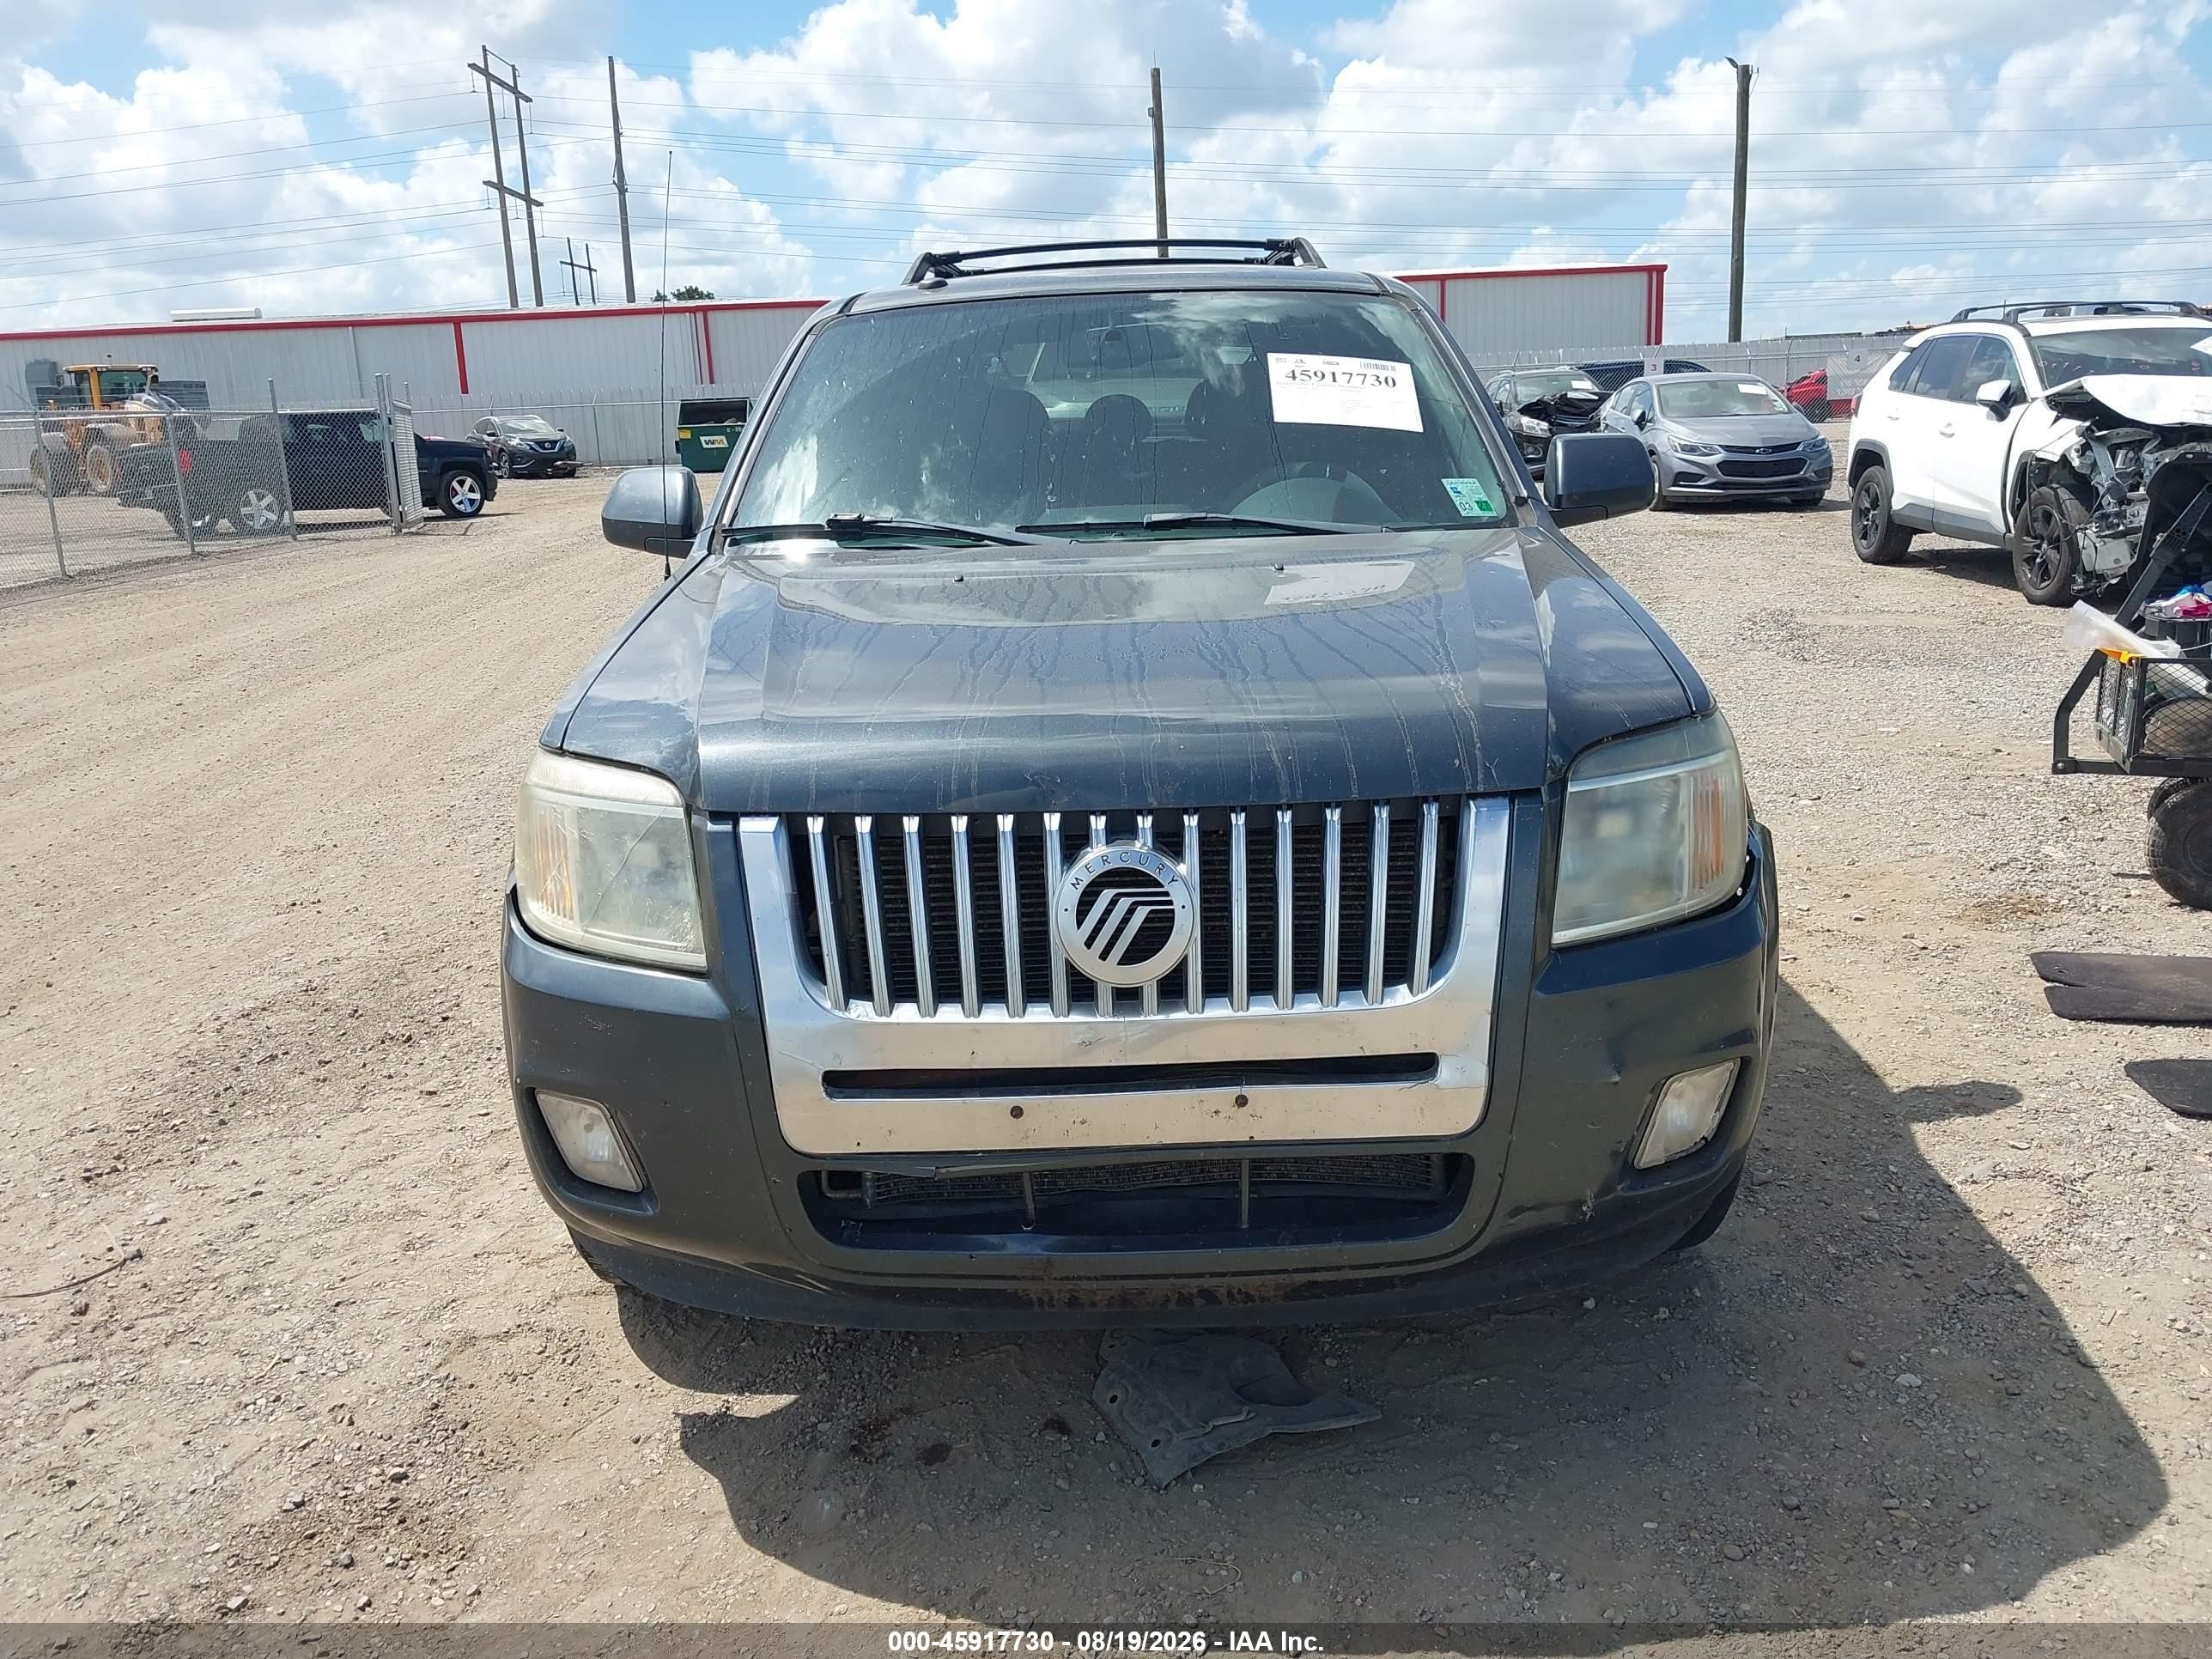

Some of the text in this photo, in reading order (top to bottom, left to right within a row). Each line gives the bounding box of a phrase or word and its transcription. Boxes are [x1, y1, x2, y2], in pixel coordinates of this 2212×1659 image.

[1285, 369, 1397, 388] 45917730
[1459, 501, 1474, 511] 03
[1070, 851, 1179, 890] MERCURY
